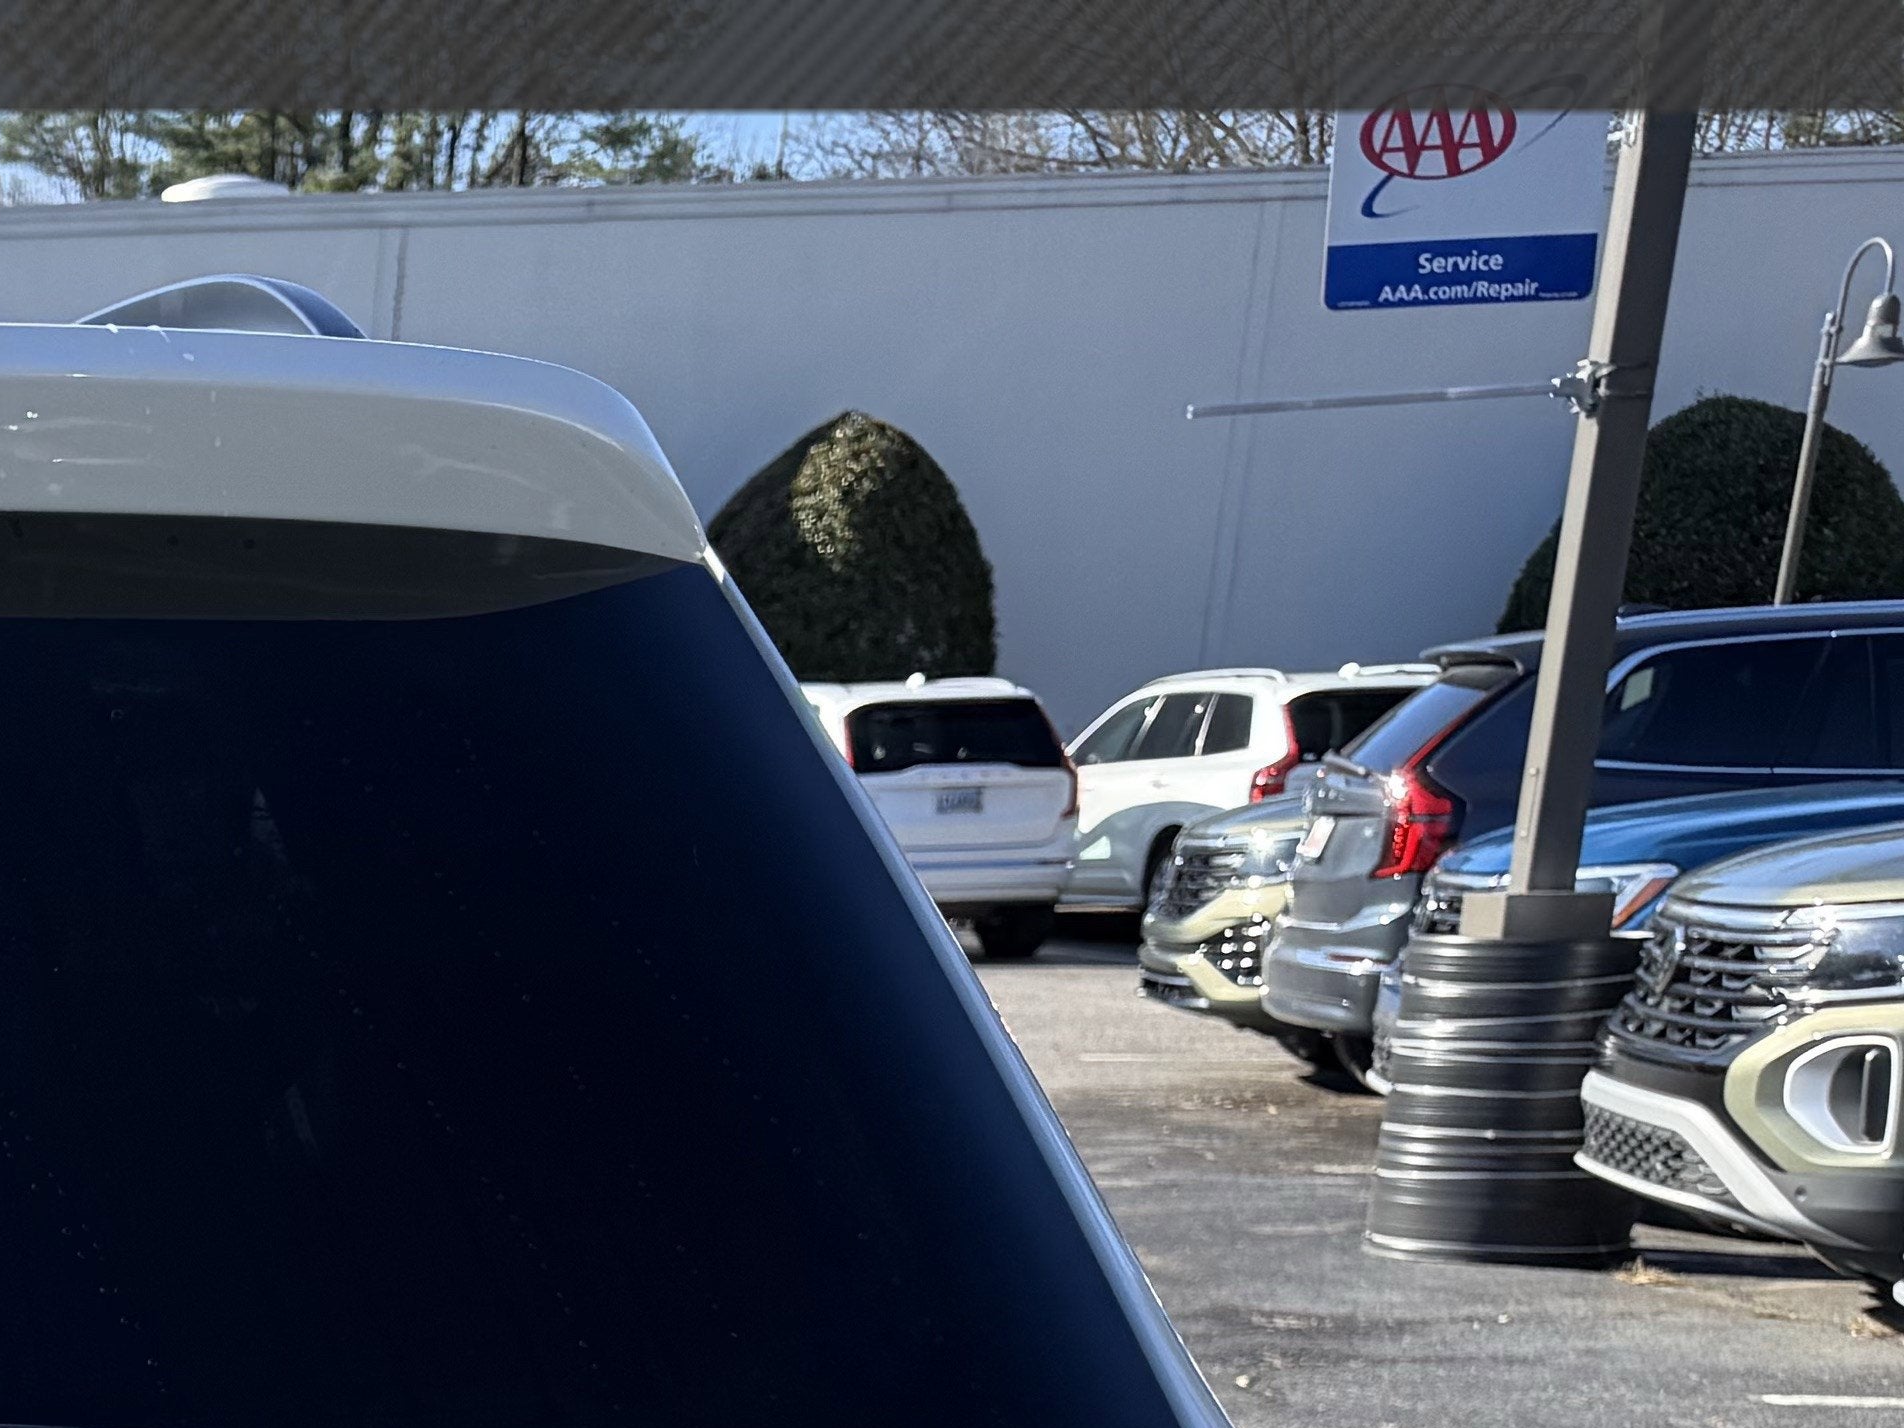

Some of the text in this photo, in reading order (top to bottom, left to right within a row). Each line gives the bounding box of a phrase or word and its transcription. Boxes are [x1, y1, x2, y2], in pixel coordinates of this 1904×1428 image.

[1372, 86, 1504, 179] AAA
[1417, 250, 1505, 274] Service
[1378, 278, 1539, 303] AAA.com/Repair
